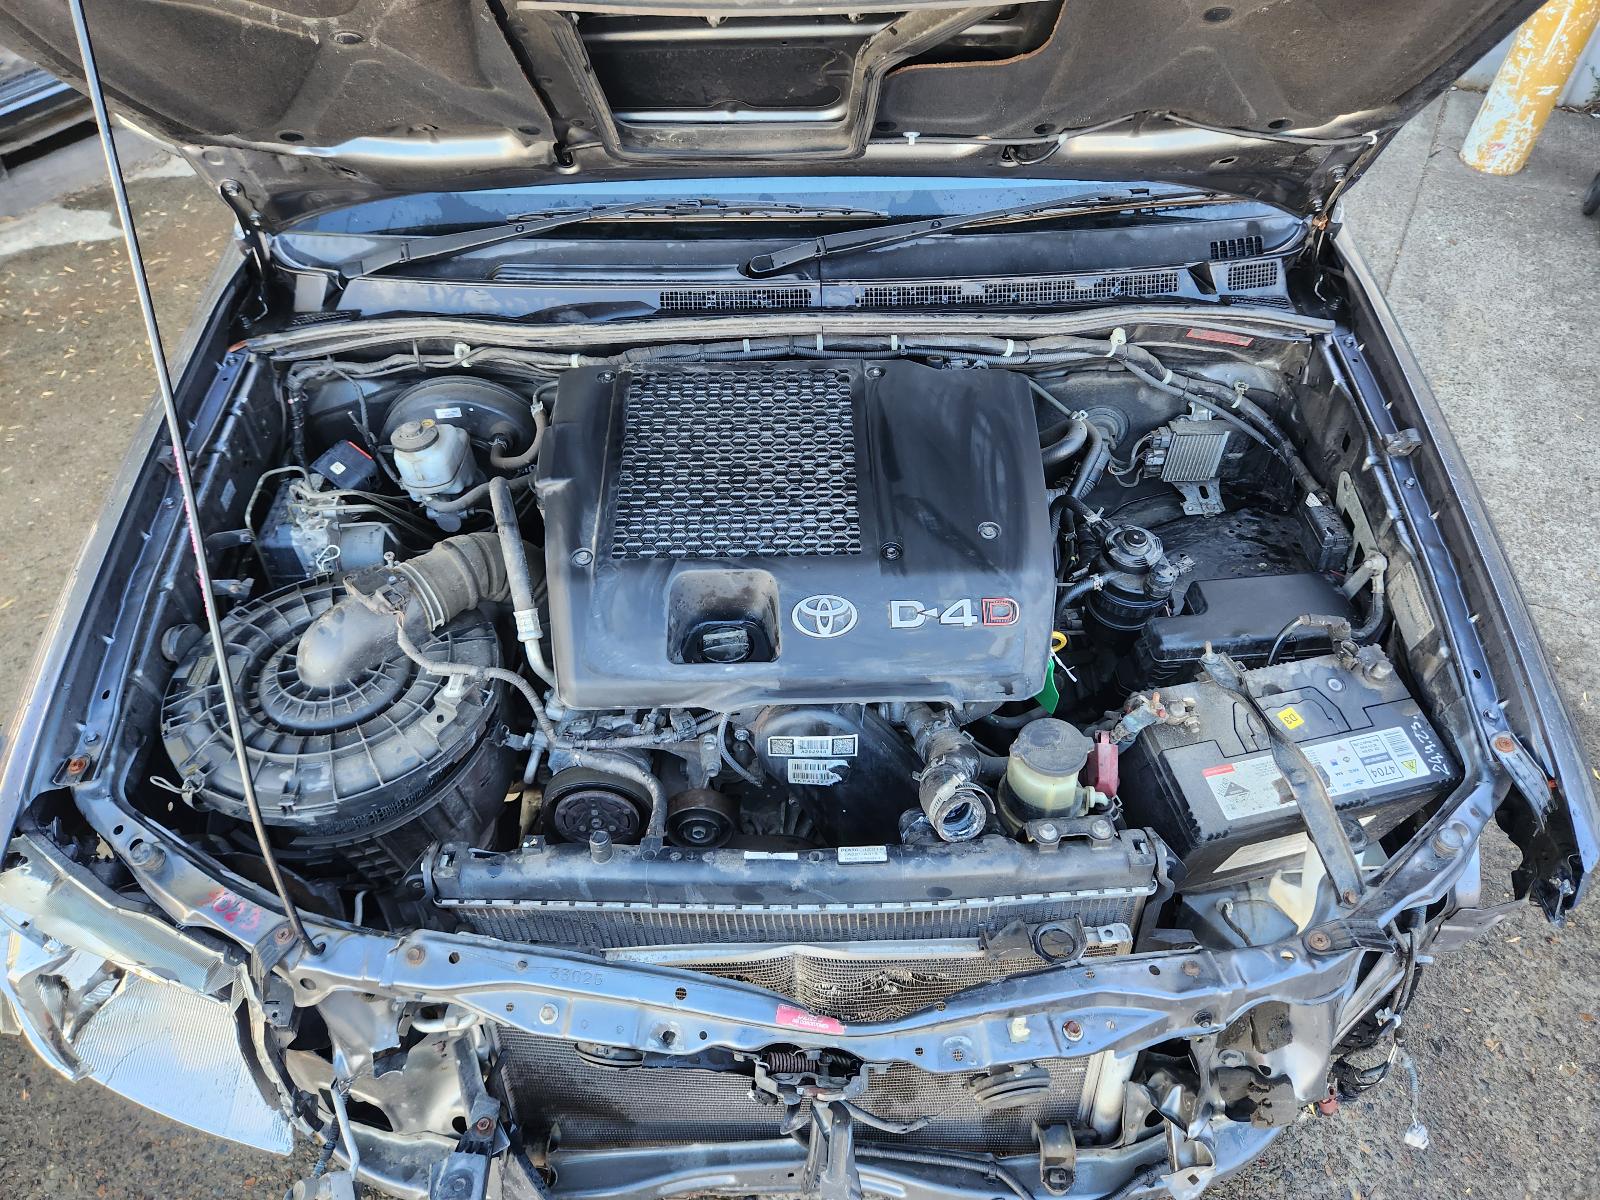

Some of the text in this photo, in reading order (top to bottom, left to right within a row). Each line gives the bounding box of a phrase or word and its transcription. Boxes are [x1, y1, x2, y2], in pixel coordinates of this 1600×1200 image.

[889, 597, 1020, 629] D-4D
[1283, 712, 1299, 725] D3
[1371, 765, 1395, 778] 4704
